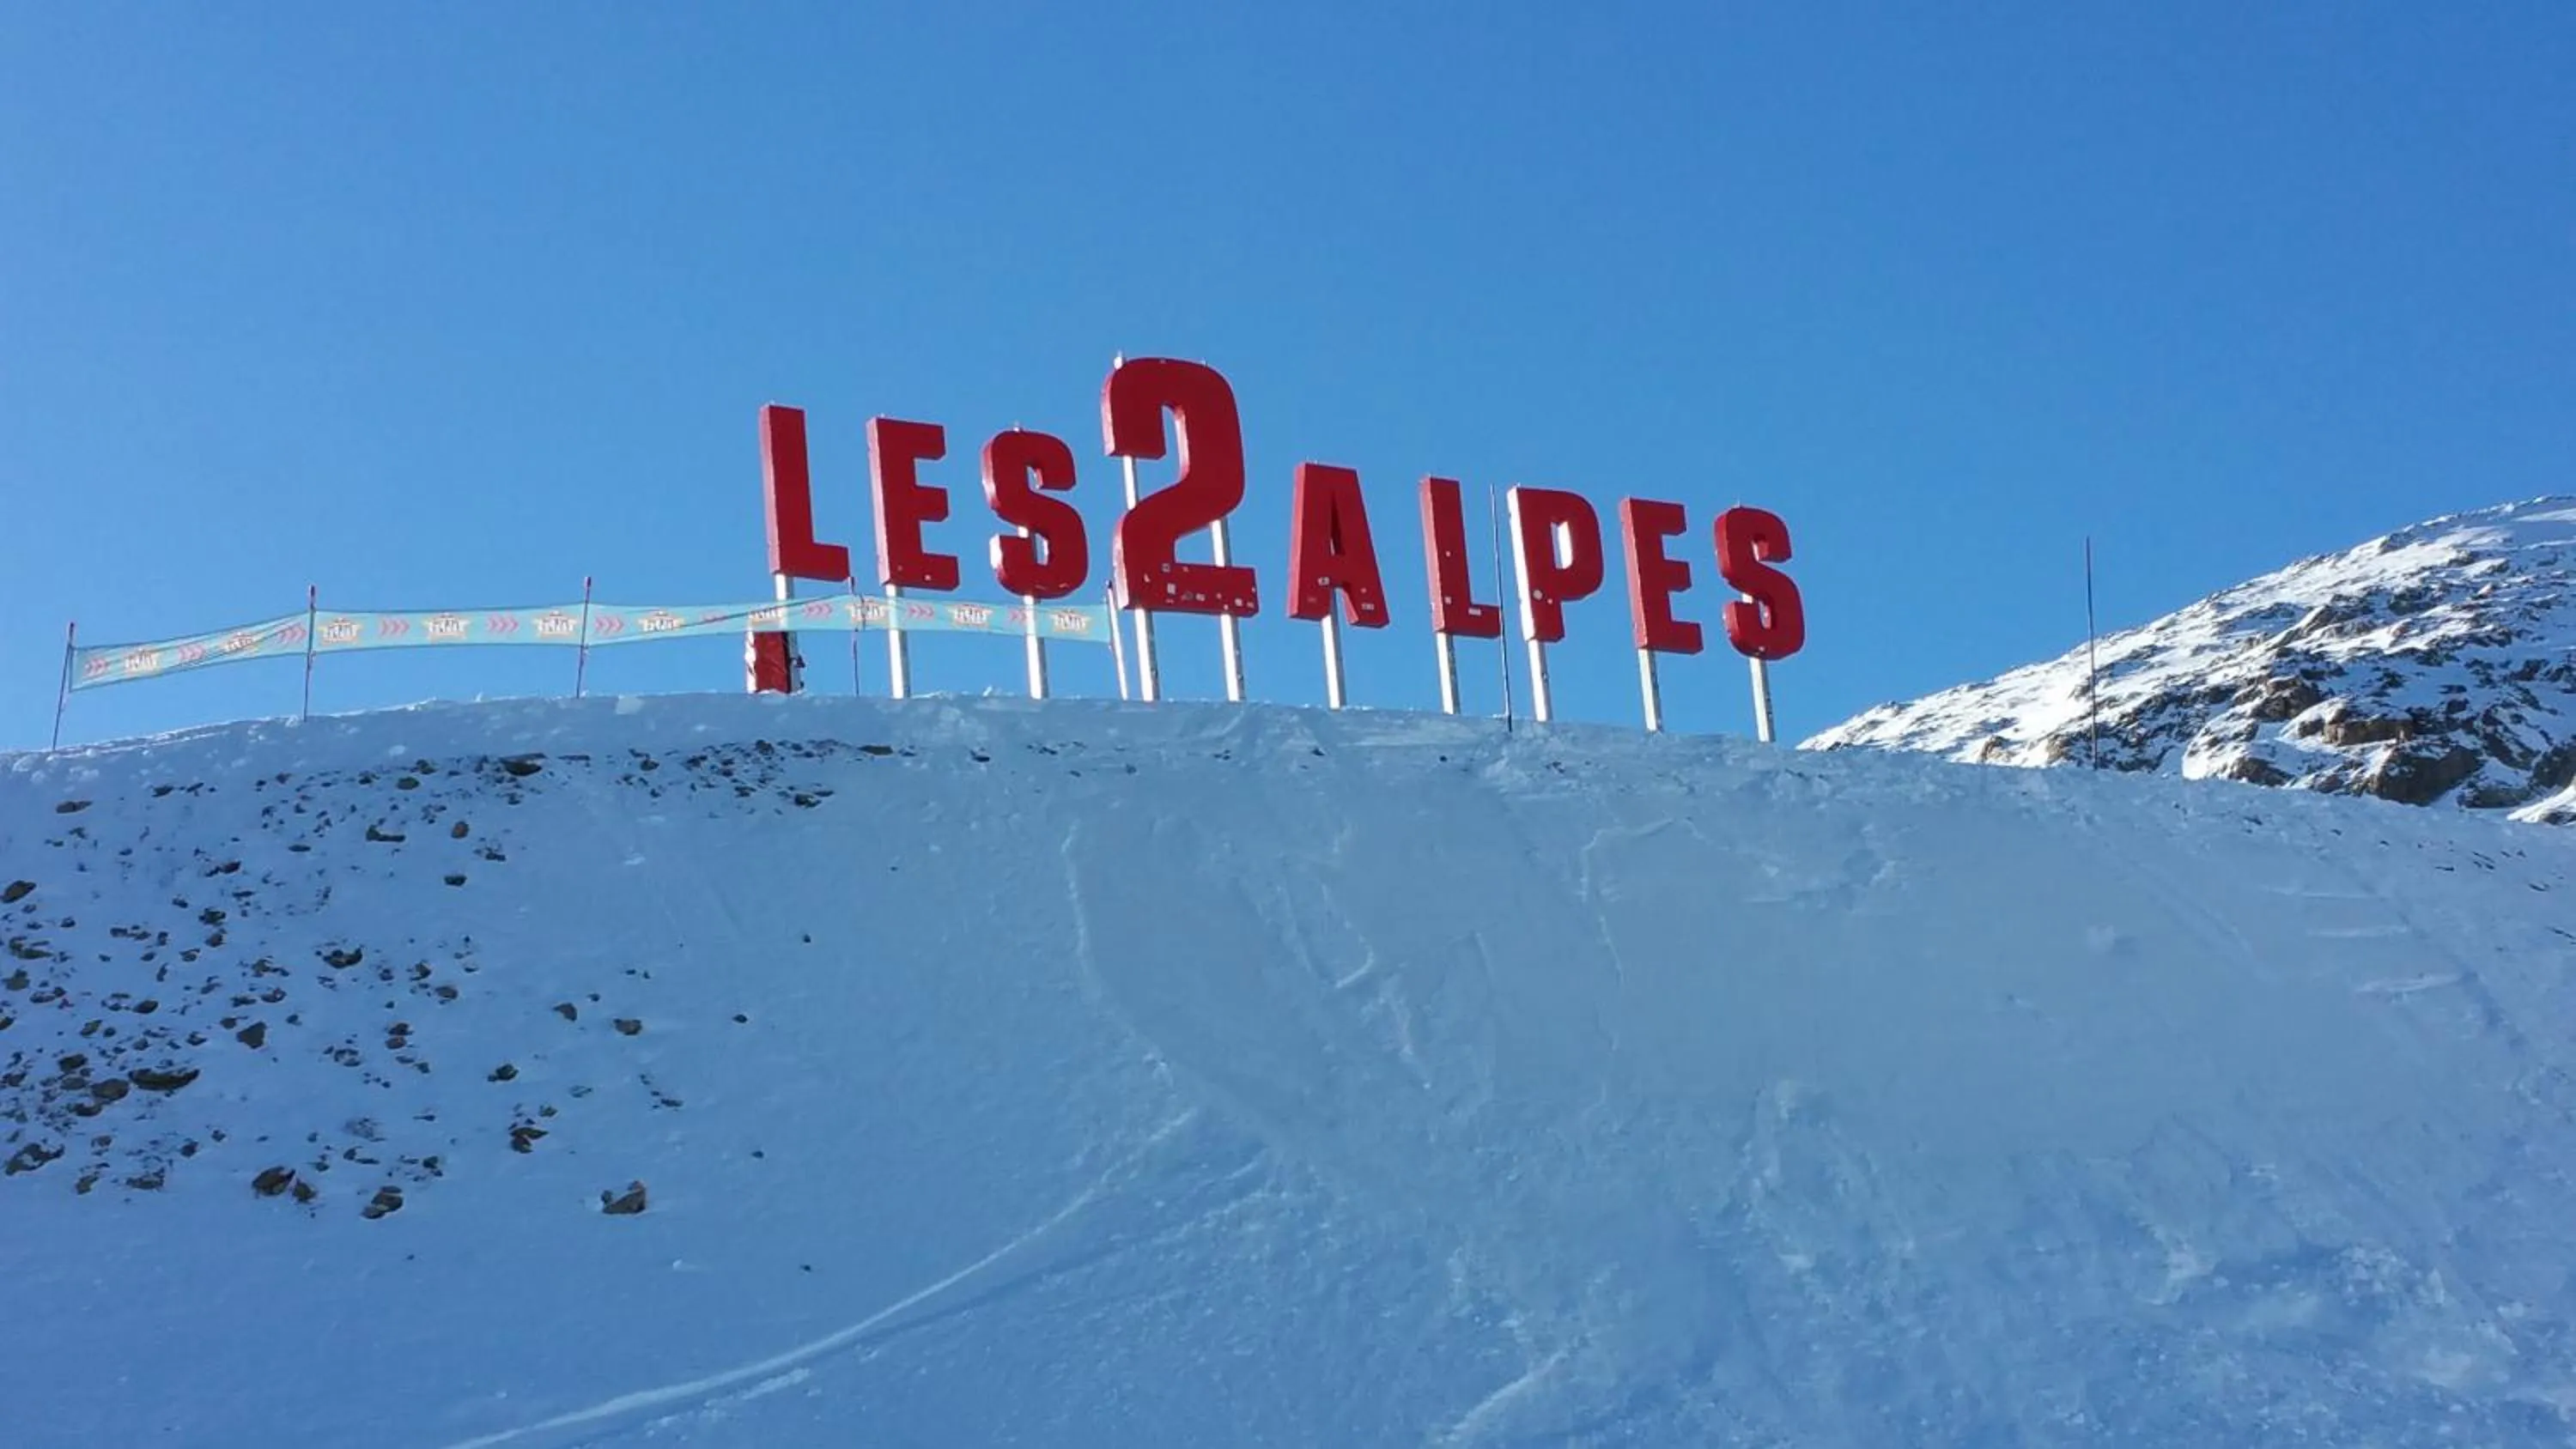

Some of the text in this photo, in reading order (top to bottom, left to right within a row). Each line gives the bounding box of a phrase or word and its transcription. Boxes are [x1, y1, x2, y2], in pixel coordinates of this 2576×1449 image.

[759, 357, 1805, 660] LES 2 ALPES
